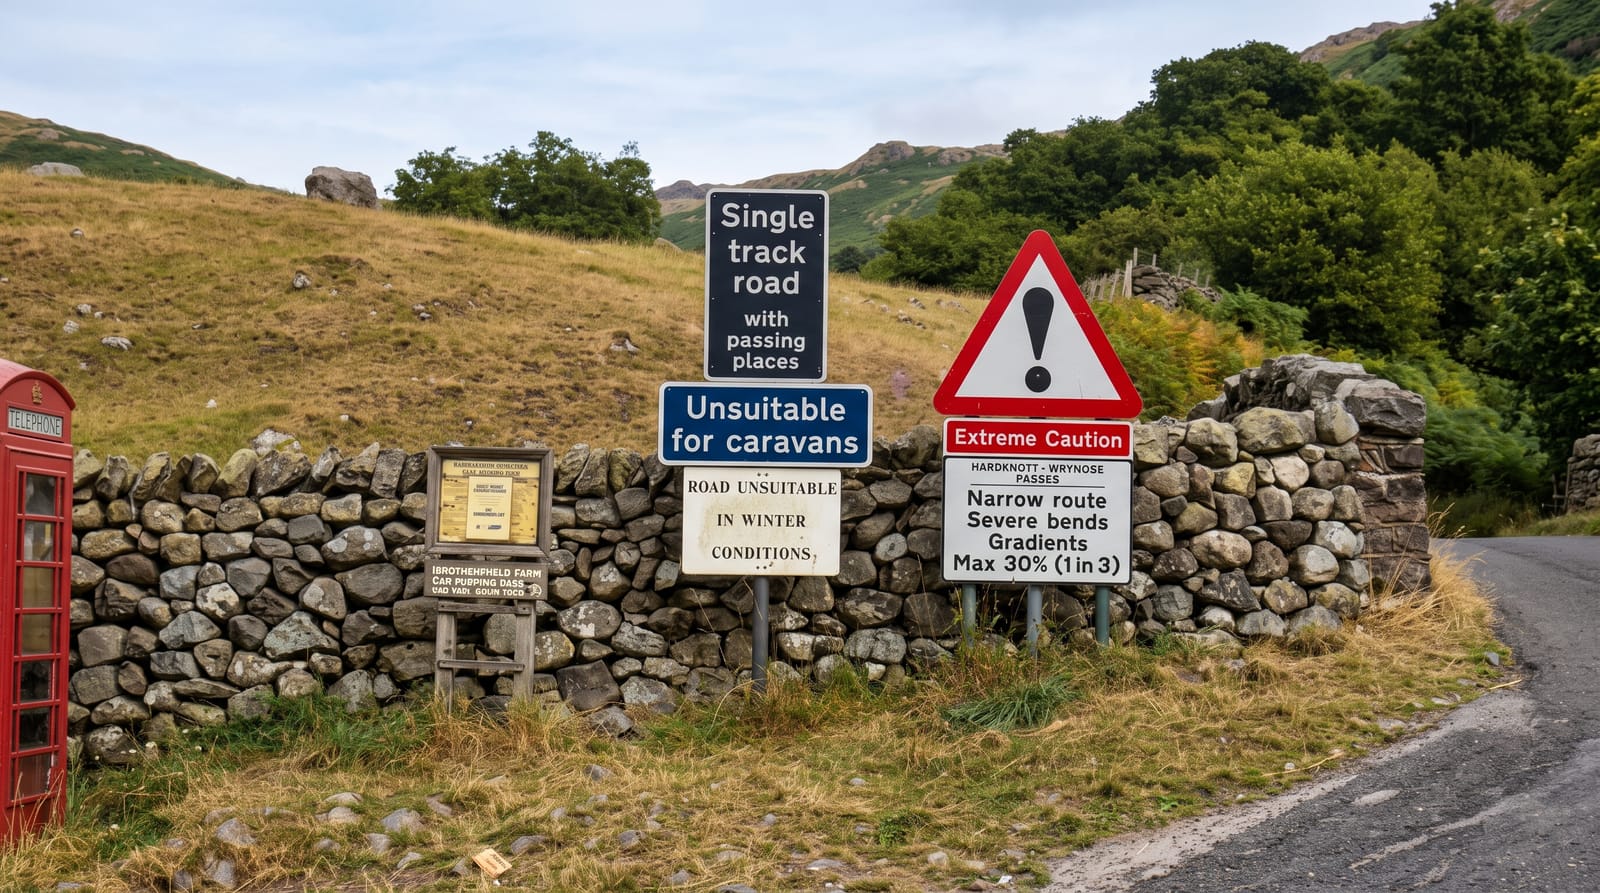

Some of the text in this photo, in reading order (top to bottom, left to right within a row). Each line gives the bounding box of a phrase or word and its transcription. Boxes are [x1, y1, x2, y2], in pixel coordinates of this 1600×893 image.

[720, 201, 815, 234] Single
[727, 238, 807, 264] track
[733, 271, 800, 295] road
[744, 310, 789, 328] with
[727, 331, 806, 352] passing
[732, 352, 799, 372] places
[686, 394, 847, 422] Unsuitable
[9, 409, 61, 435] TELEPHONE
[671, 427, 859, 455] for caravans
[954, 428, 1123, 449] Extreme Caution
[971, 462, 1039, 473] HARDKNOTT
[1048, 464, 1104, 474] WRYNOSE
[687, 480, 838, 495] ROAD UNSUITABLE
[1015, 474, 1060, 484] PASSES
[967, 490, 1107, 509] Narrow route
[717, 513, 807, 528] IN WINTER
[967, 511, 1109, 531] Severe bends
[711, 546, 811, 560] CONDITIONS
[988, 534, 1088, 552] Gradients
[514, 568, 542, 578] FARM
[953, 554, 1121, 577] Max 30% (1 in 3)
[432, 576, 452, 585] CAR
